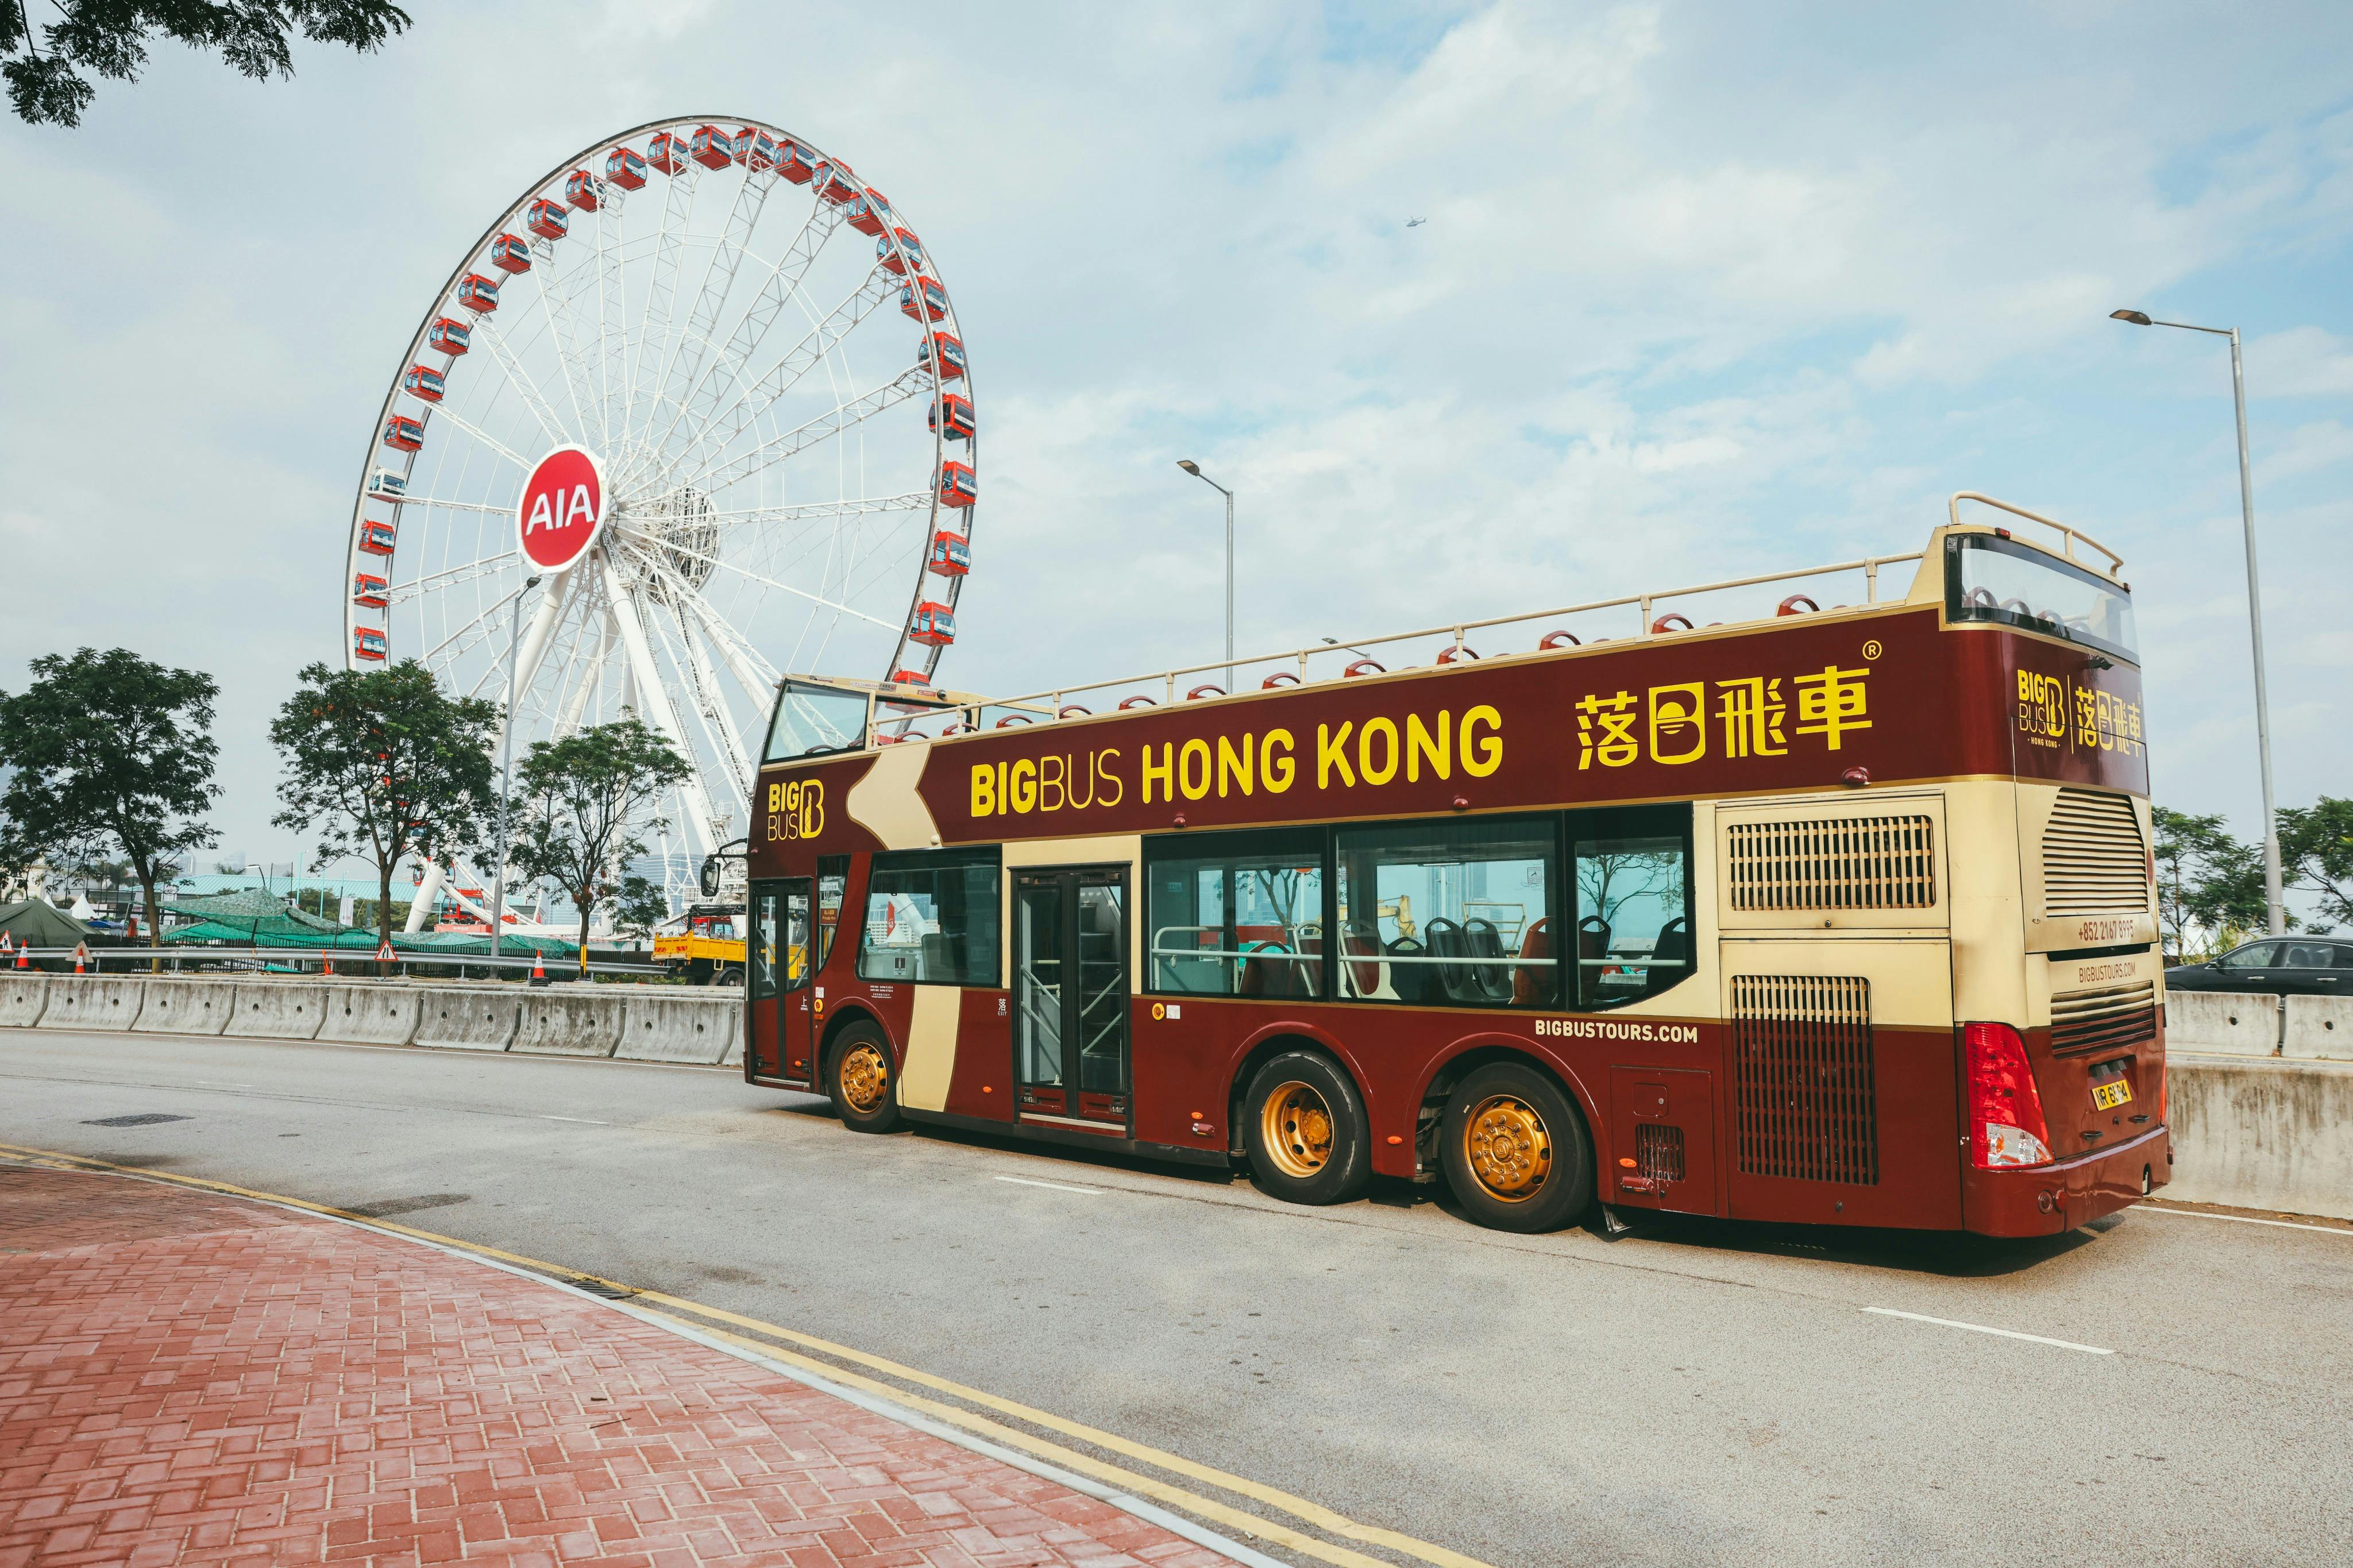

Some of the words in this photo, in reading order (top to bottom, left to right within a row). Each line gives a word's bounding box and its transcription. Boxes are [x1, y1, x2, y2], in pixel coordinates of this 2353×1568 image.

[526, 484, 595, 536] AIA
[2018, 669, 2045, 704] BIG
[2019, 703, 2046, 735] BUS
[2031, 737, 2044, 746] HONG
[2045, 739, 2058, 748] KONG
[971, 749, 1123, 817] BIGBUS
[1143, 729, 1295, 804] HONG
[1318, 705, 1503, 789] KONG
[769, 782, 799, 813] BIG
[768, 813, 798, 841] BUS
[2078, 921, 2099, 941] +852
[2100, 921, 2116, 940] 2167
[2119, 920, 2134, 939] 8995
[2079, 961, 2136, 983] BIGBUSTOURS.COM
[801, 995, 808, 1007] 上
[998, 998, 1006, 1011] 落
[1535, 1020, 1698, 1044] BIGBUSTOURS.COM
